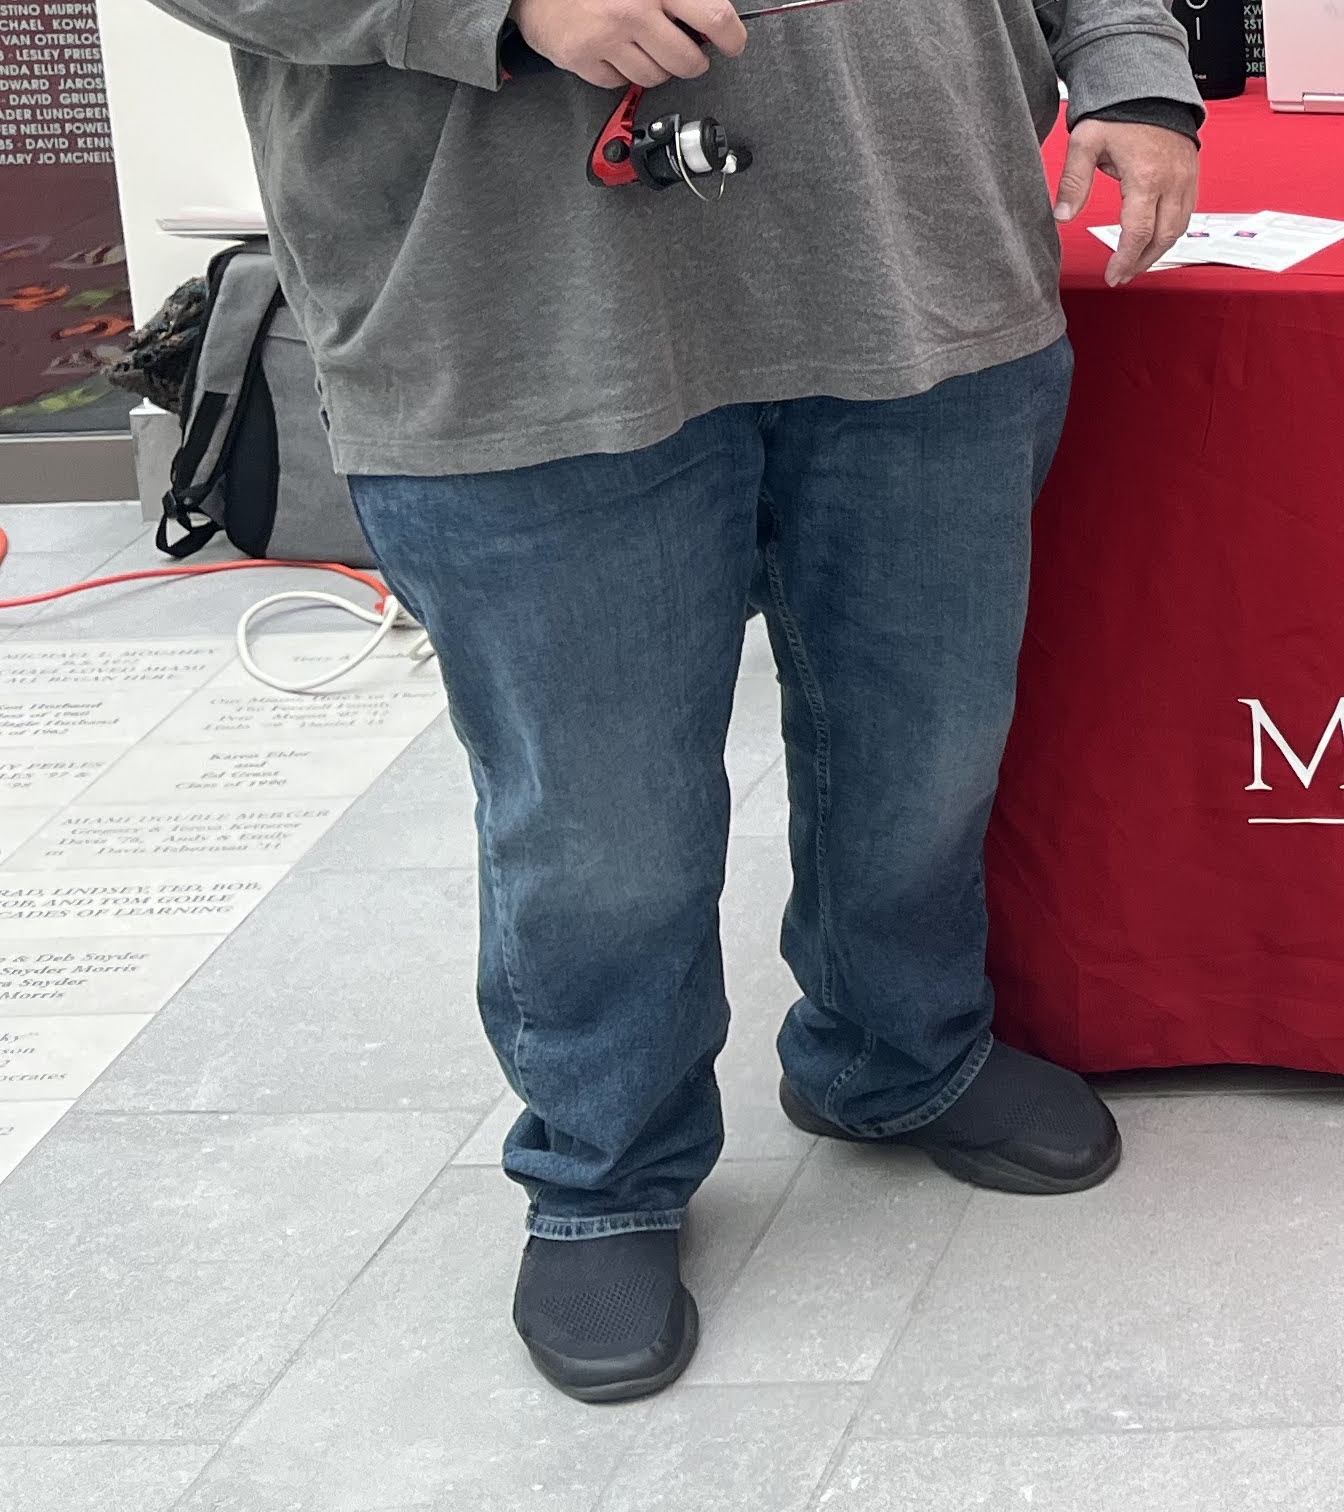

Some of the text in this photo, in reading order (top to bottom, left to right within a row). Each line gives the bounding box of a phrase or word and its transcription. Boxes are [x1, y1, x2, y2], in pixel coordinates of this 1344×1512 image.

[16, 48, 60, 62] LESLEY
[100, 896, 152, 905] TOM
[114, 906, 235, 916] LEARNING
[36, 952, 151, 964] Deb Snyder
[1, 964, 139, 977] Snyder Morris
[19, 978, 88, 988] Snyder
